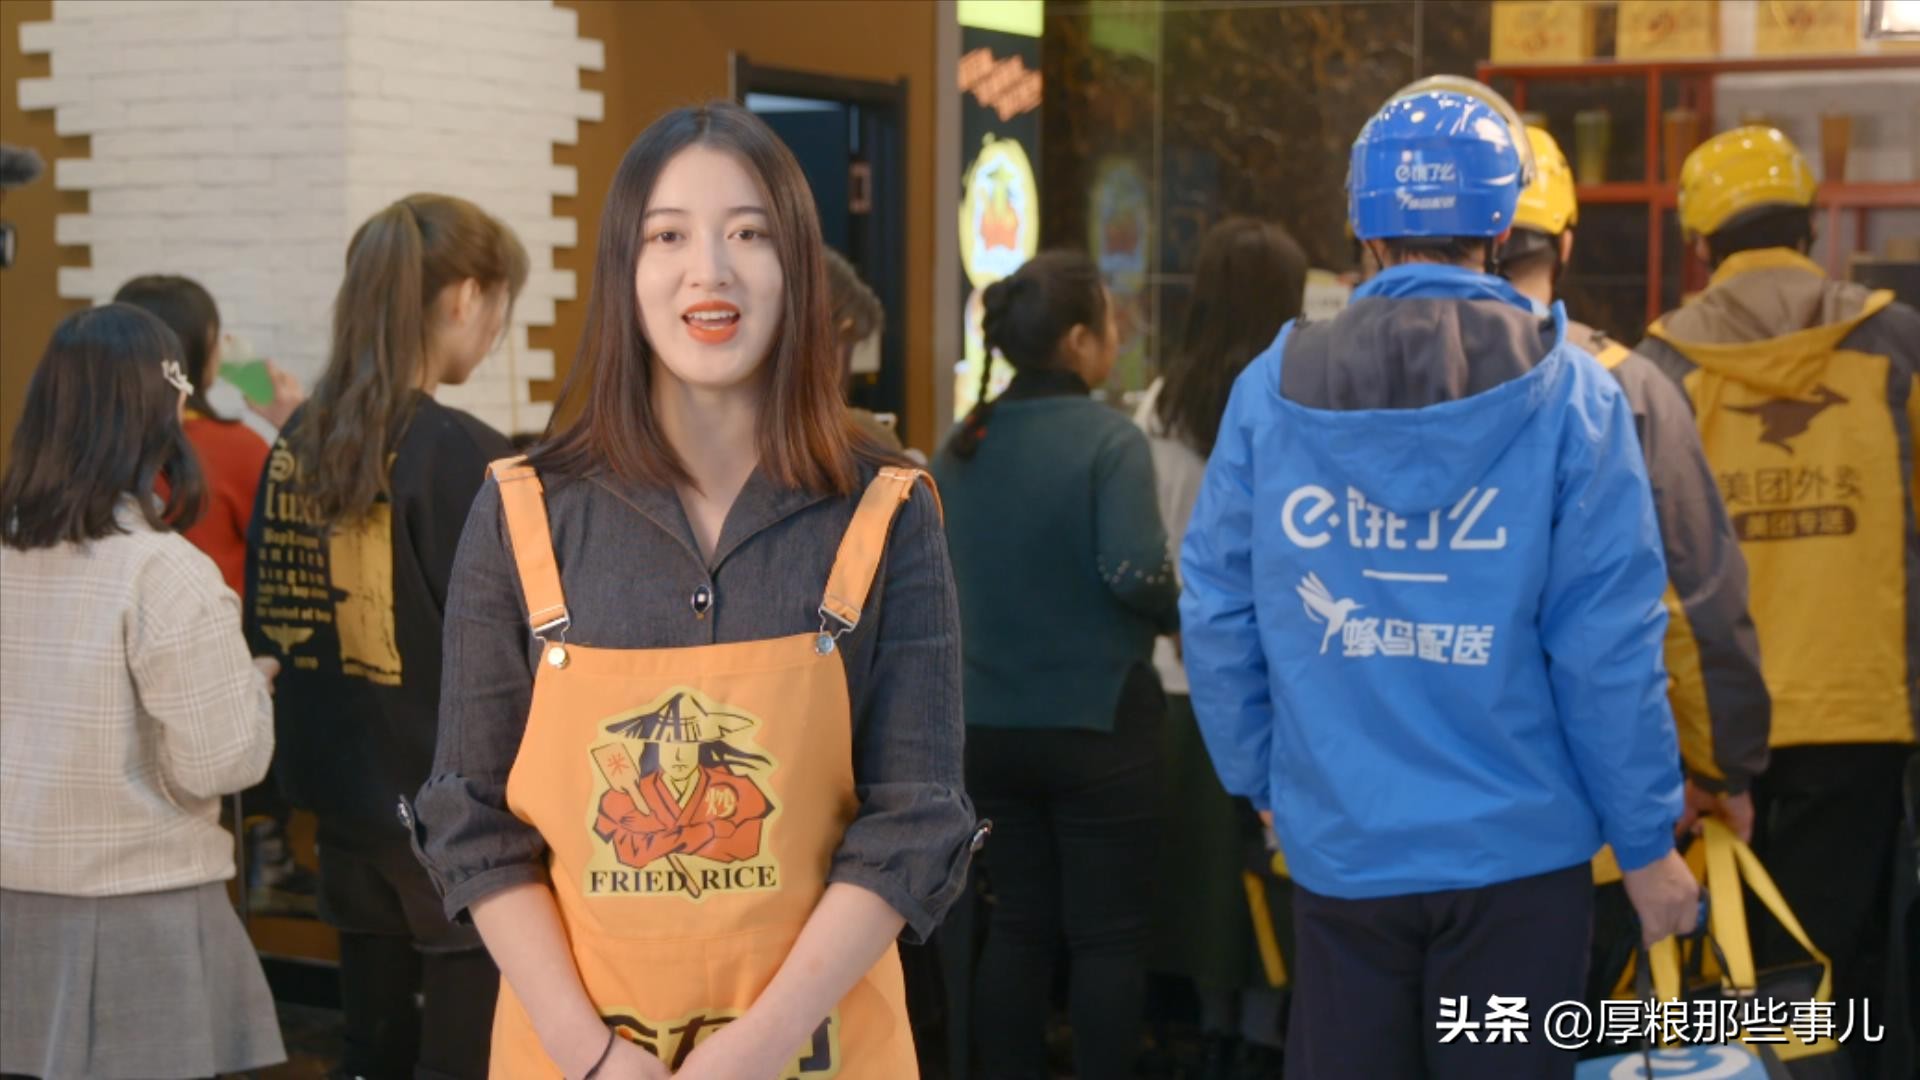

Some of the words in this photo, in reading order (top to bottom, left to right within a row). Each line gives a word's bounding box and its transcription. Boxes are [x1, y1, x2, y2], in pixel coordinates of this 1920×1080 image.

[1343, 617, 1494, 666] 蜂鸟配送
[589, 869, 688, 894] FRIED
[701, 865, 777, 890] RICE
